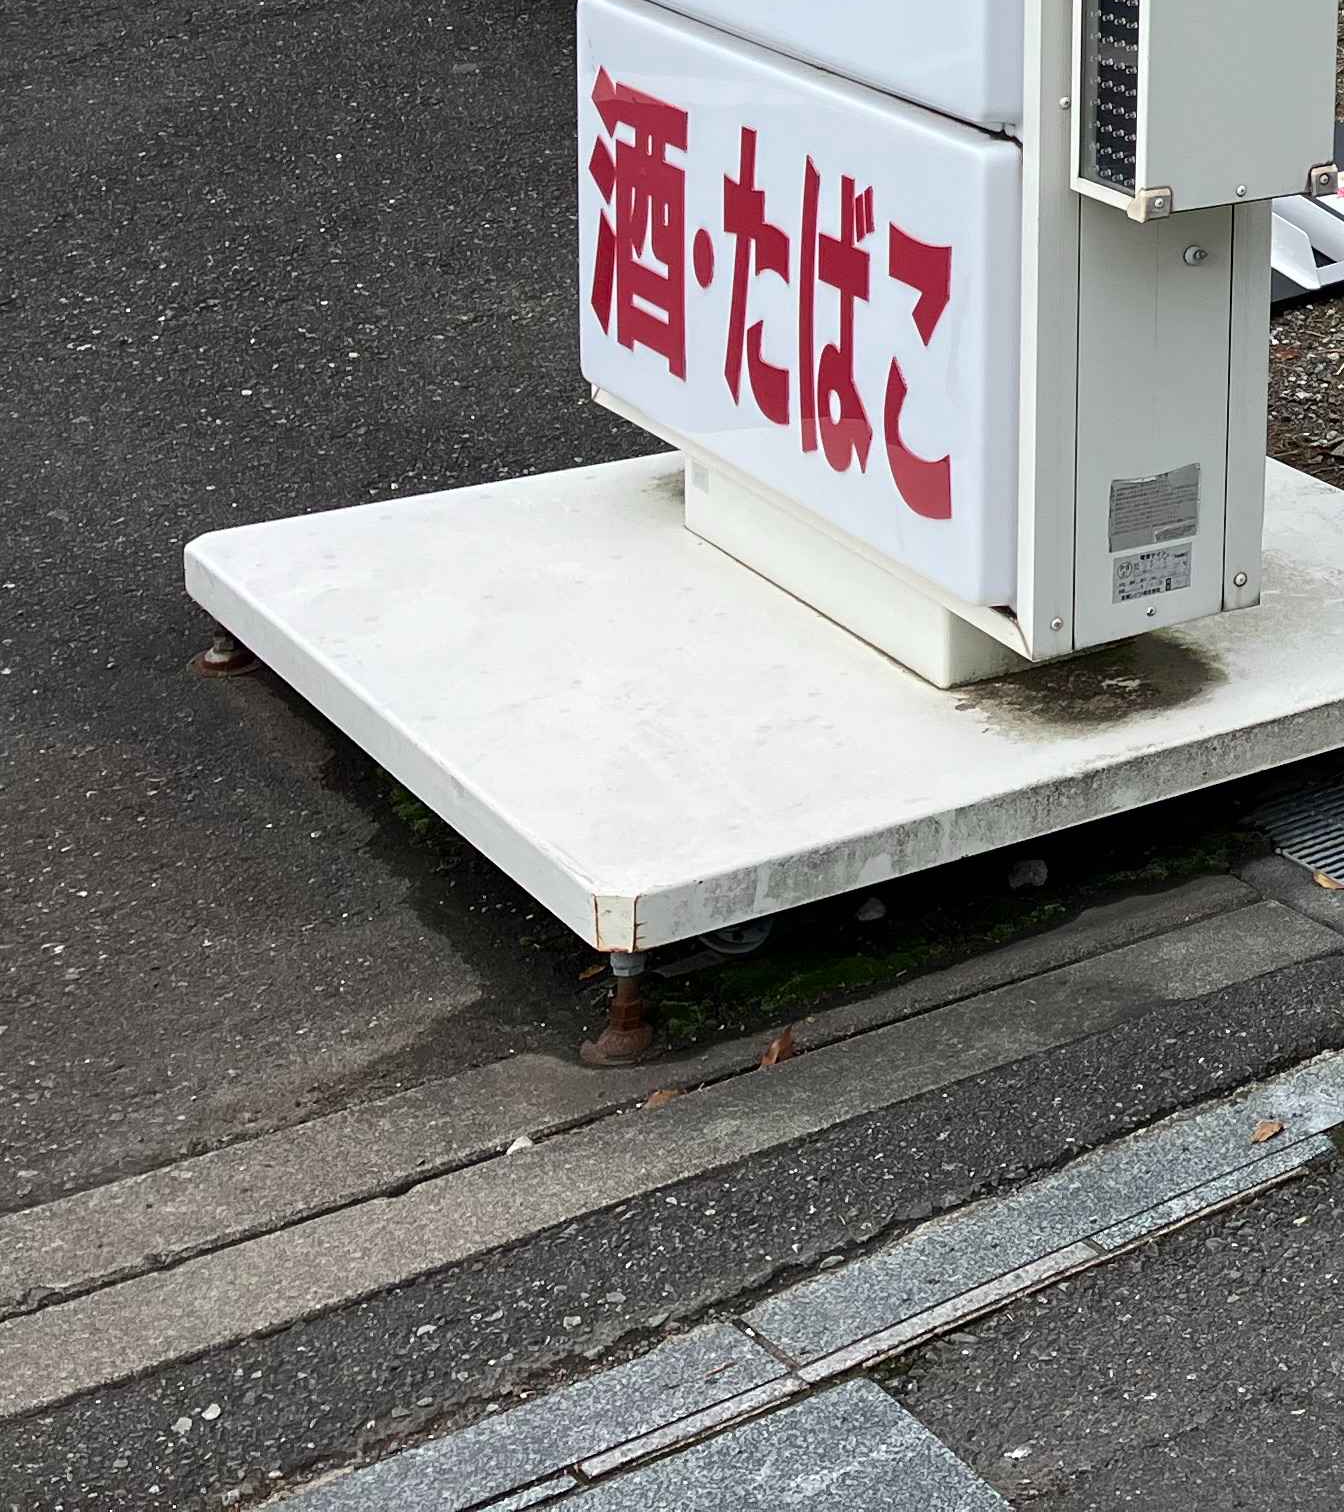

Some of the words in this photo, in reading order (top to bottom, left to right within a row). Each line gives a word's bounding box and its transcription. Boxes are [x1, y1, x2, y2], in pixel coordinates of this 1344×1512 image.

[588, 65, 952, 519] 酒・たばこ
